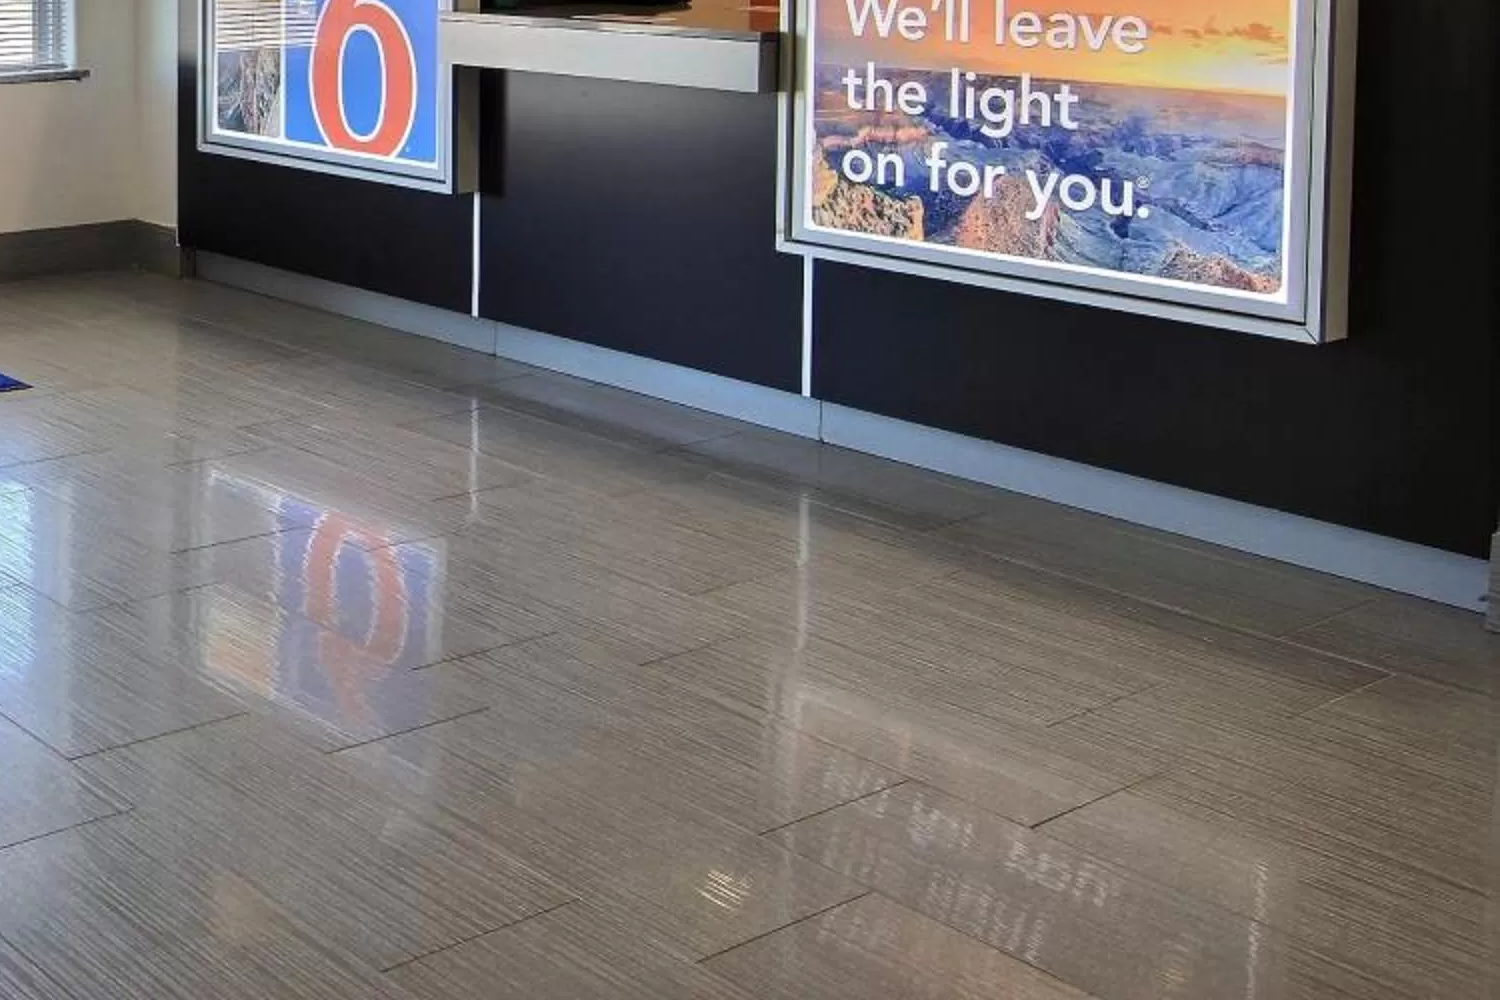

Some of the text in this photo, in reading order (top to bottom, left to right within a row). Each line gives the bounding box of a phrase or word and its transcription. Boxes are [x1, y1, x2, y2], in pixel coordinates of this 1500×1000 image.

[842, 62, 1079, 138] the light
[842, 149, 904, 187] on
[926, 141, 1006, 199] for
